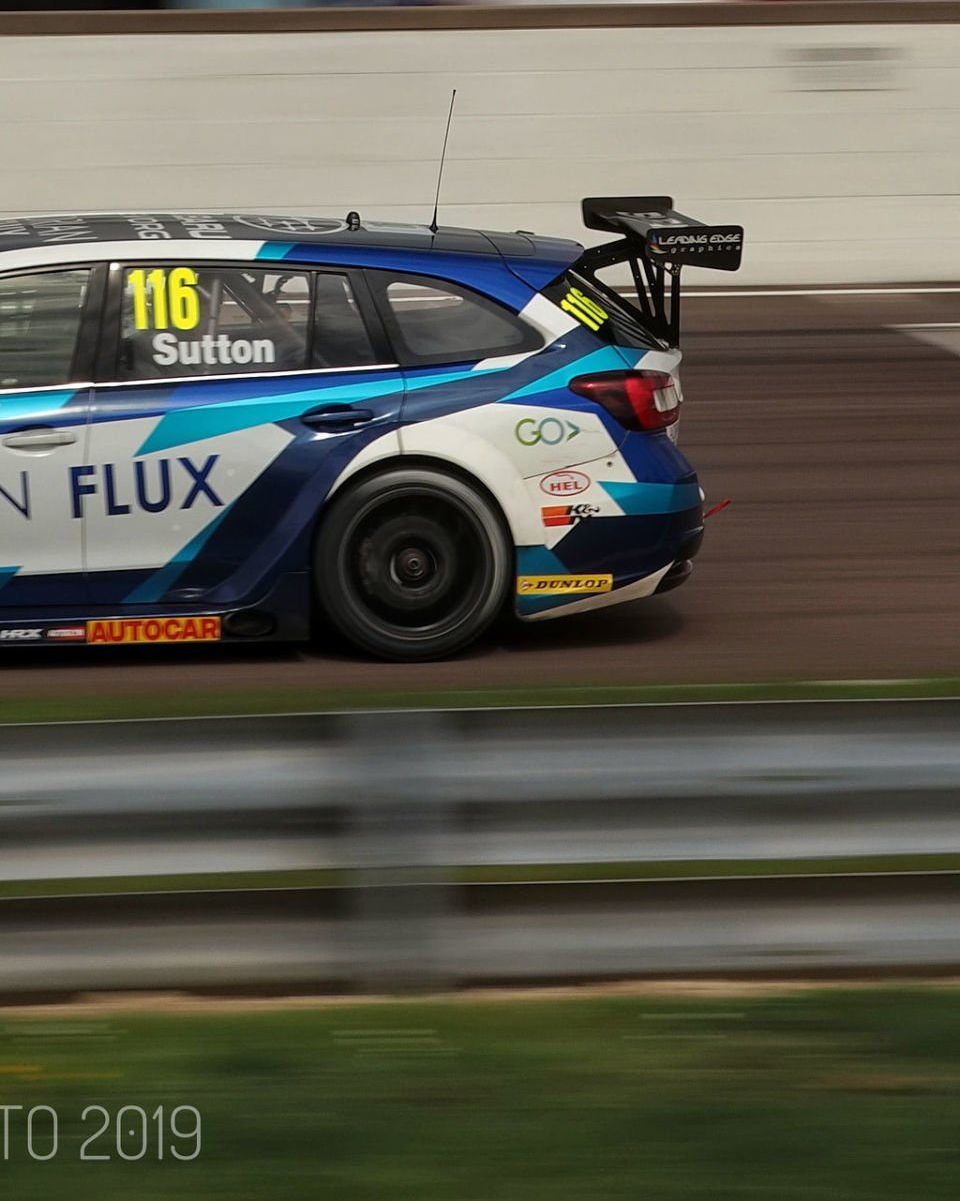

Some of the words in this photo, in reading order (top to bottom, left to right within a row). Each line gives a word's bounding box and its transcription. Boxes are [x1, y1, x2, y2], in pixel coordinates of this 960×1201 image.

[658, 234, 707, 245] LEADING
[709, 233, 741, 243] EDGE
[128, 267, 199, 330] 116
[560, 287, 609, 332] 116
[152, 332, 276, 366] Sutton
[68, 454, 225, 519] FLUX
[550, 481, 582, 492] HEL
[535, 578, 608, 590] DUNLOP
[90, 618, 218, 643] AUTOCAR
